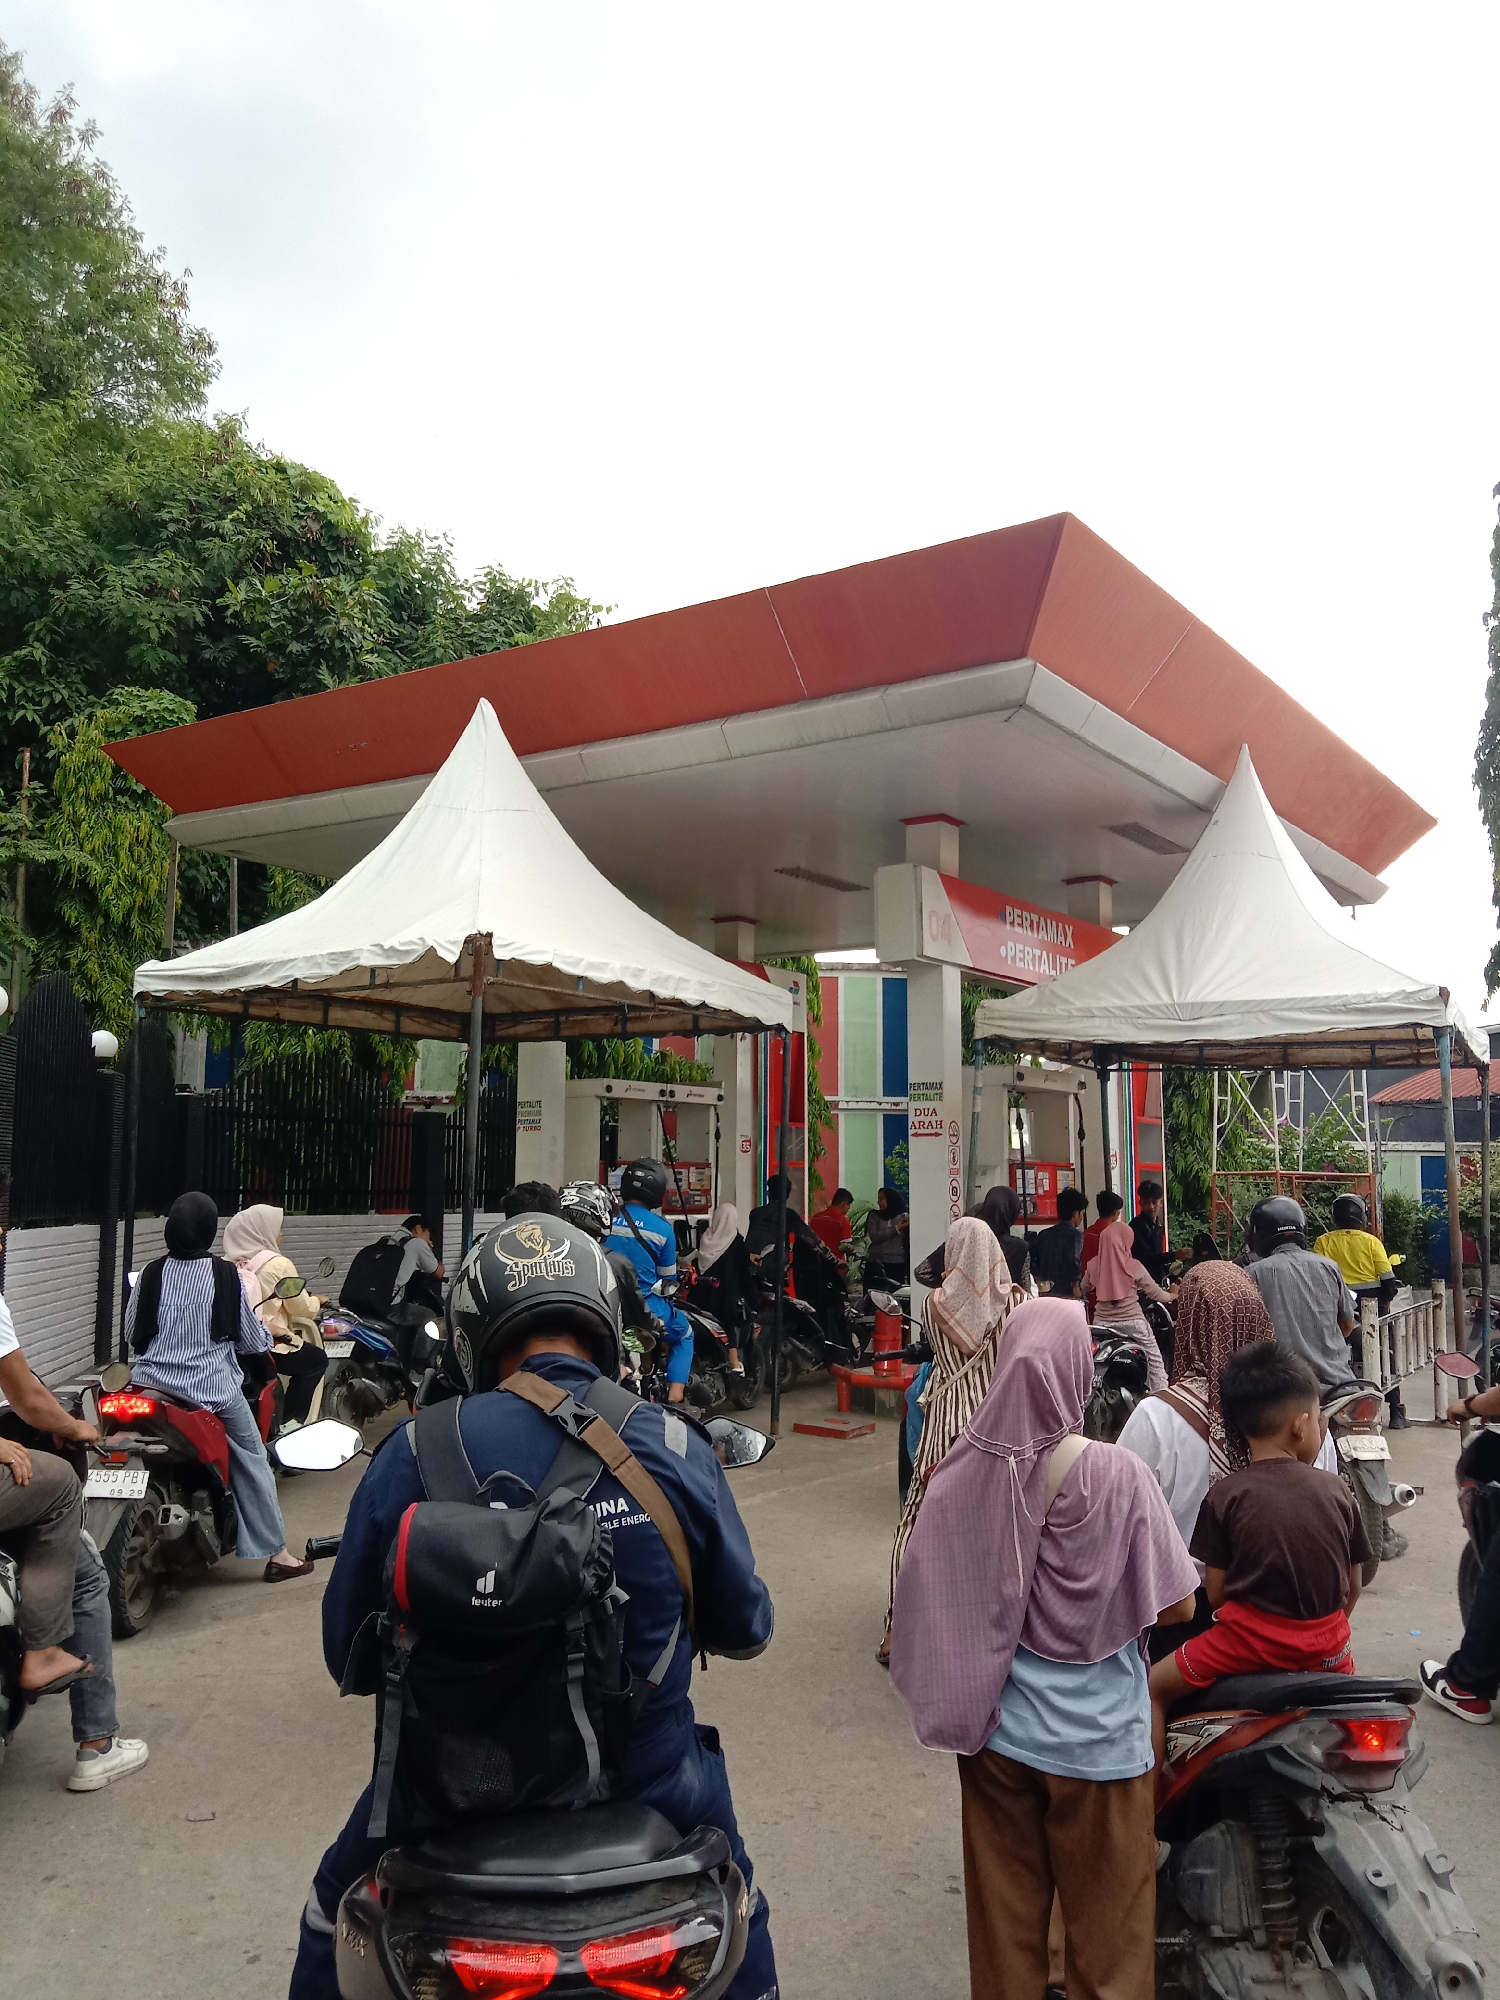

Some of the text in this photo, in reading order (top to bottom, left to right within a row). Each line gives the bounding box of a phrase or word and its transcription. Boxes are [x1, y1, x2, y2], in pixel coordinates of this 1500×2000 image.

[1005, 905, 1075, 949] PERTAMAX
[909, 1081, 944, 1091] PERTAMAX
[909, 1092, 944, 1102] PERTALITE
[517, 1100, 542, 1109] PERTALITE
[914, 1107, 938, 1117] DUA
[909, 1120, 944, 1130] ARAH
[122, 1470, 149, 1484] PBT
